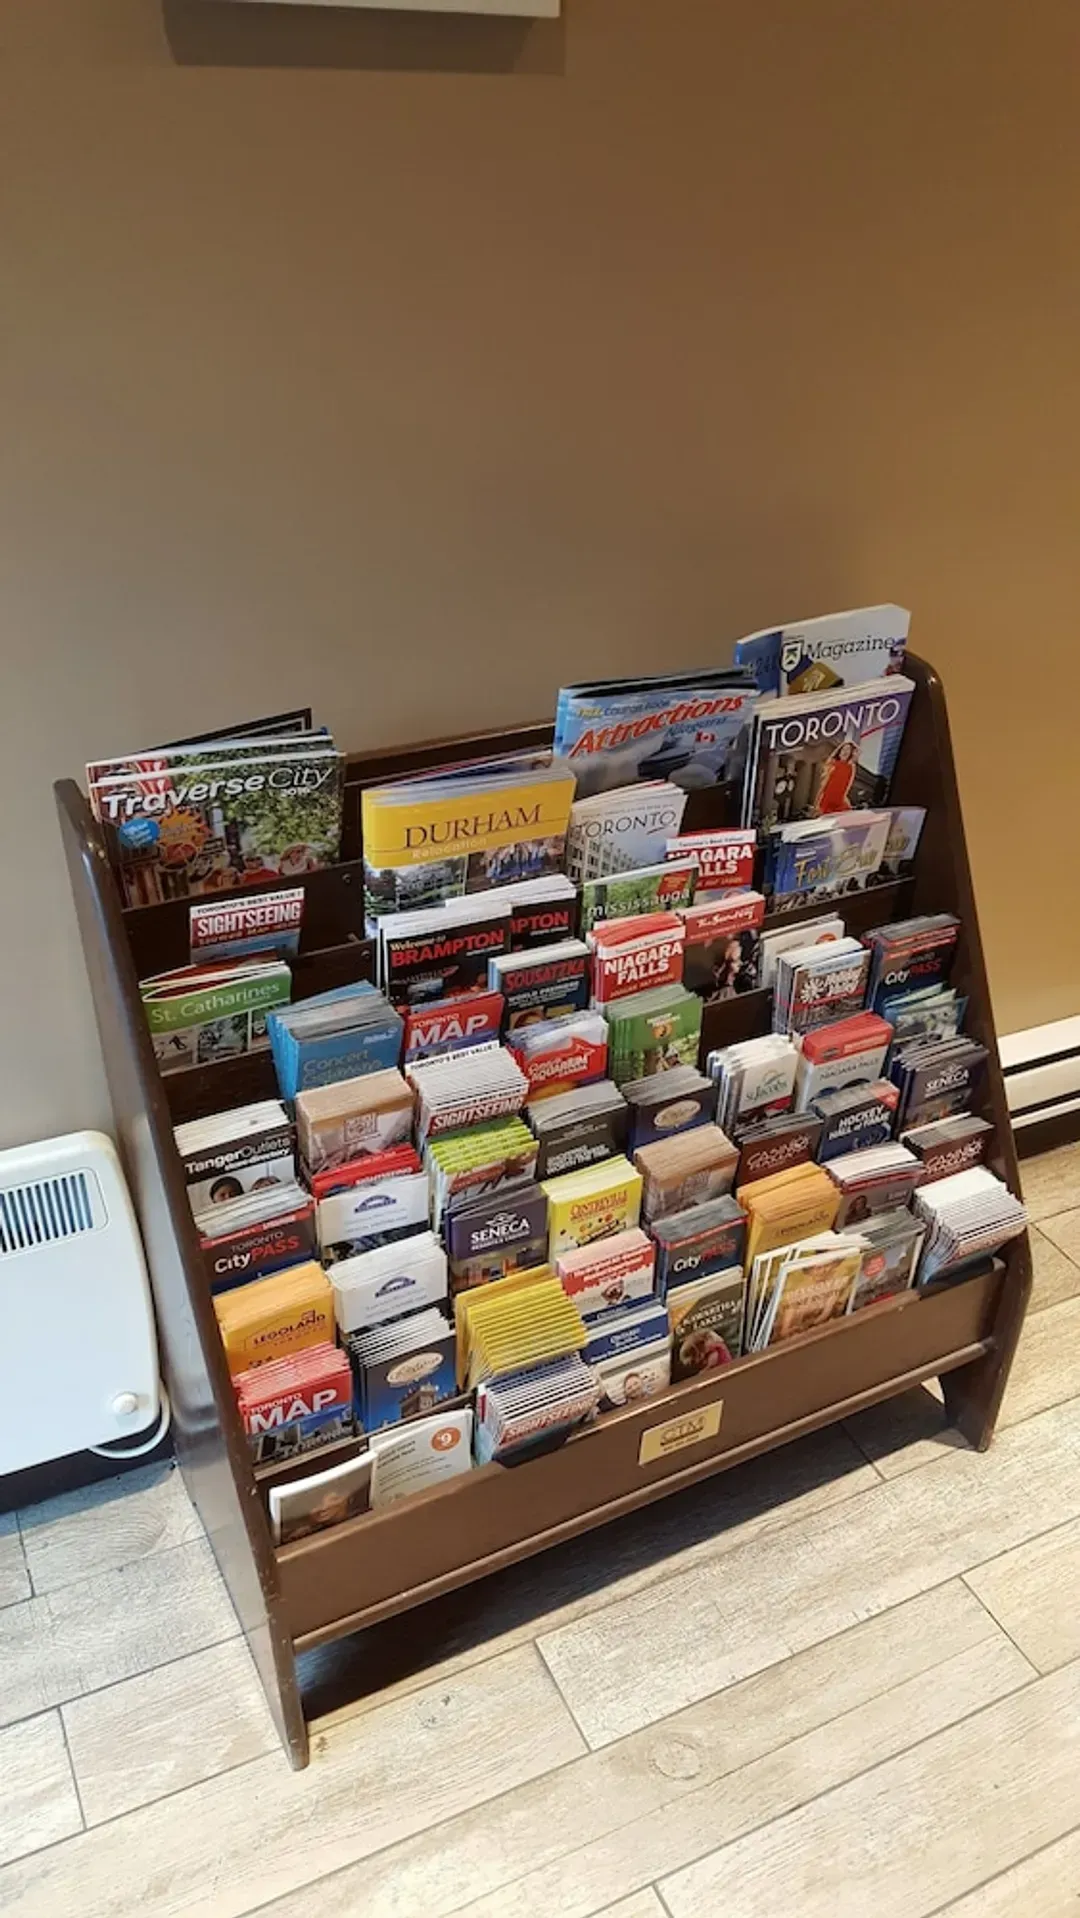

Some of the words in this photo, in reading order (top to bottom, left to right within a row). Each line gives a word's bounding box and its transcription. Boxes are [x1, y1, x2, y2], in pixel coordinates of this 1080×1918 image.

[805, 634, 897, 661] Magazine
[568, 694, 748, 758] Attractions
[765, 699, 901, 750] TORONTO
[102, 773, 264, 819] Traverse
[268, 765, 334, 791] City
[405, 803, 544, 849] DURHAM
[197, 902, 301, 937] SIGHTSEEING
[391, 929, 504, 968] BRAMPTON
[604, 941, 683, 976] NIAGARA
[616, 958, 670, 985] FALLS
[152, 1008, 177, 1024] St.
[180, 981, 280, 1017] Catharines
[409, 1014, 489, 1051] MAP
[412, 1013, 460, 1029] TORONTO
[433, 1096, 524, 1130] SIGHTSEEING
[231, 1230, 285, 1253] TORONTO
[471, 1218, 530, 1243] SENECA
[252, 1312, 327, 1346] LEGOLAND
[249, 1388, 338, 1436] MAP
